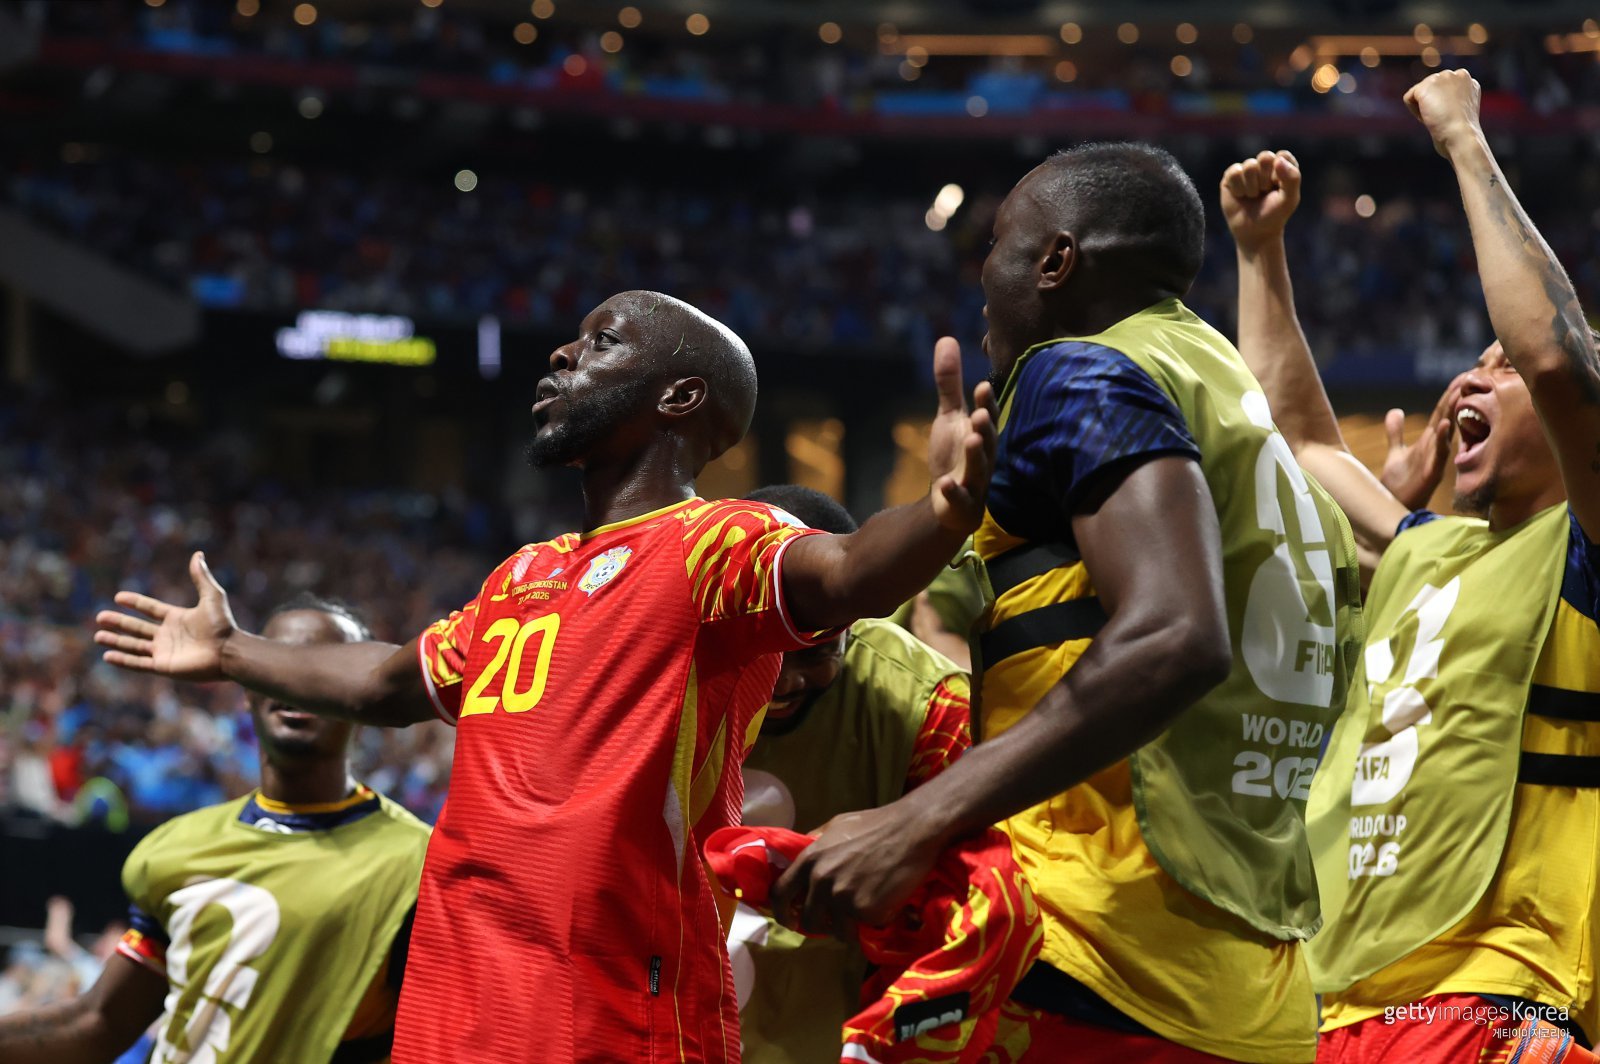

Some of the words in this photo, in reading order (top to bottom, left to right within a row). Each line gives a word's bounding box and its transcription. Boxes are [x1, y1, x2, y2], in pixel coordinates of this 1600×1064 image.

[531, 591, 550, 600] 2026
[460, 612, 561, 718] 20
[1295, 640, 1335, 677] FIA
[1348, 841, 1401, 880] 026
